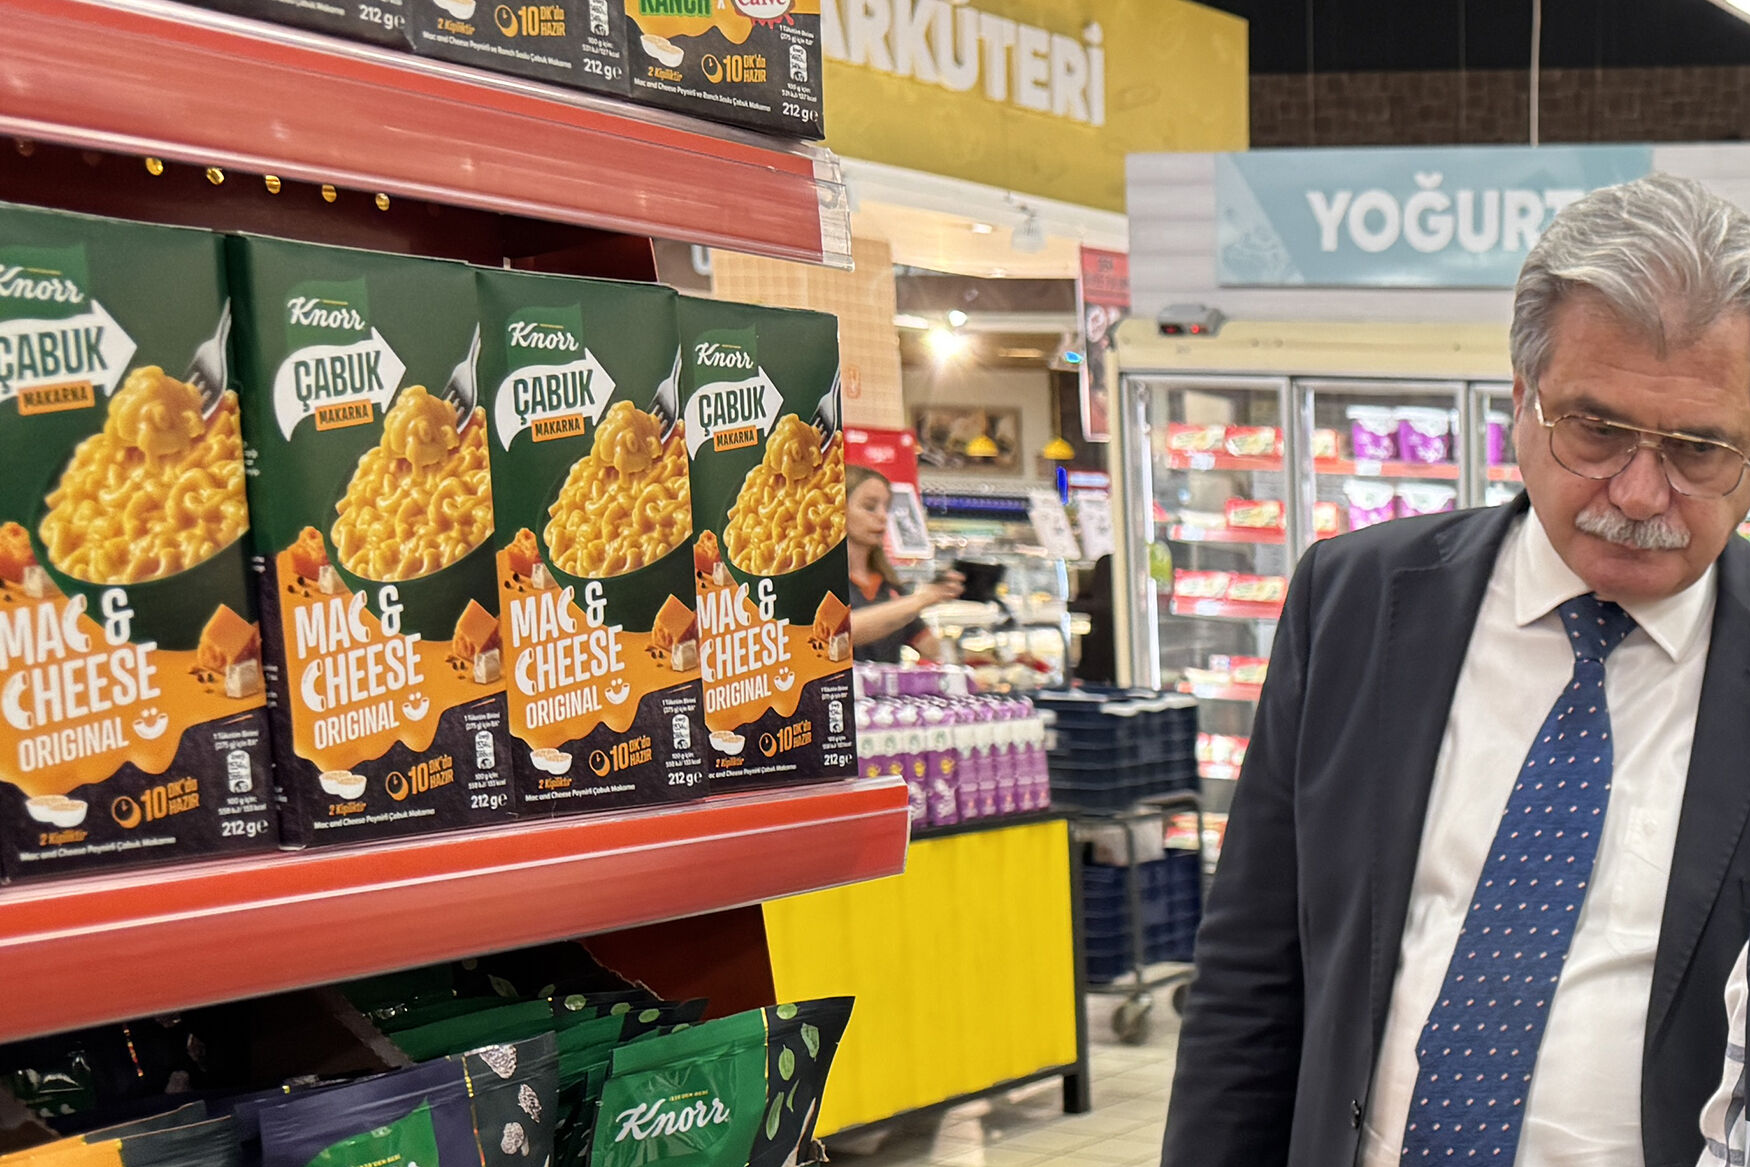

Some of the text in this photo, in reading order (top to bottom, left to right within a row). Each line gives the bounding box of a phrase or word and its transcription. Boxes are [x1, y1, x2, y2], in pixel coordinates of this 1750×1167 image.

[358, 4, 381, 23] 212
[438, 18, 444, 29] 2
[519, 6, 539, 36] 10
[541, 21, 566, 36] HAZIR
[583, 58, 603, 75] 212
[648, 66, 654, 77] 2
[724, 54, 740, 83] 10
[743, 69, 767, 83] HAZIR
[782, 102, 800, 117] 212
[288, 297, 365, 330] Knorr
[508, 321, 579, 352] Knorr
[695, 342, 754, 370] Knorr
[293, 349, 386, 413] ÇABUK
[23, 386, 88, 408] MAKARNA
[513, 369, 596, 425] ÇABUK
[699, 385, 766, 435] ÇABUK
[318, 404, 371, 427] MAKARNA
[535, 418, 582, 437] MAKARNA
[715, 428, 755, 447] MAKARNA
[294, 585, 404, 659] MAC &
[510, 581, 607, 647] MAC &
[696, 578, 777, 638] MAC &
[0, 588, 134, 670] MAC &
[514, 624, 626, 696] CHEESE
[700, 618, 791, 683] CHEESE
[2, 641, 161, 730] CHEESE
[301, 632, 424, 713] CHEESE
[525, 685, 602, 730] ORIGINAL
[705, 674, 772, 714] ORIGINAL
[314, 699, 399, 750] ORIGINAL
[18, 717, 129, 772] ORIGINAL
[777, 731, 793, 753] 10
[793, 732, 812, 748] HAZIR
[609, 744, 629, 772] 10
[630, 748, 652, 766] HAZIR
[824, 754, 838, 766] 212
[408, 762, 429, 795] 10
[430, 769, 454, 789] HAZIR
[538, 779, 545, 789] 2
[668, 773, 686, 786] 212
[140, 786, 166, 823] 10
[168, 792, 200, 815] HAZIR
[329, 804, 336, 816] 2
[470, 794, 490, 809] 212
[222, 820, 244, 837] 212
[615, 1098, 731, 1142] Knorr
